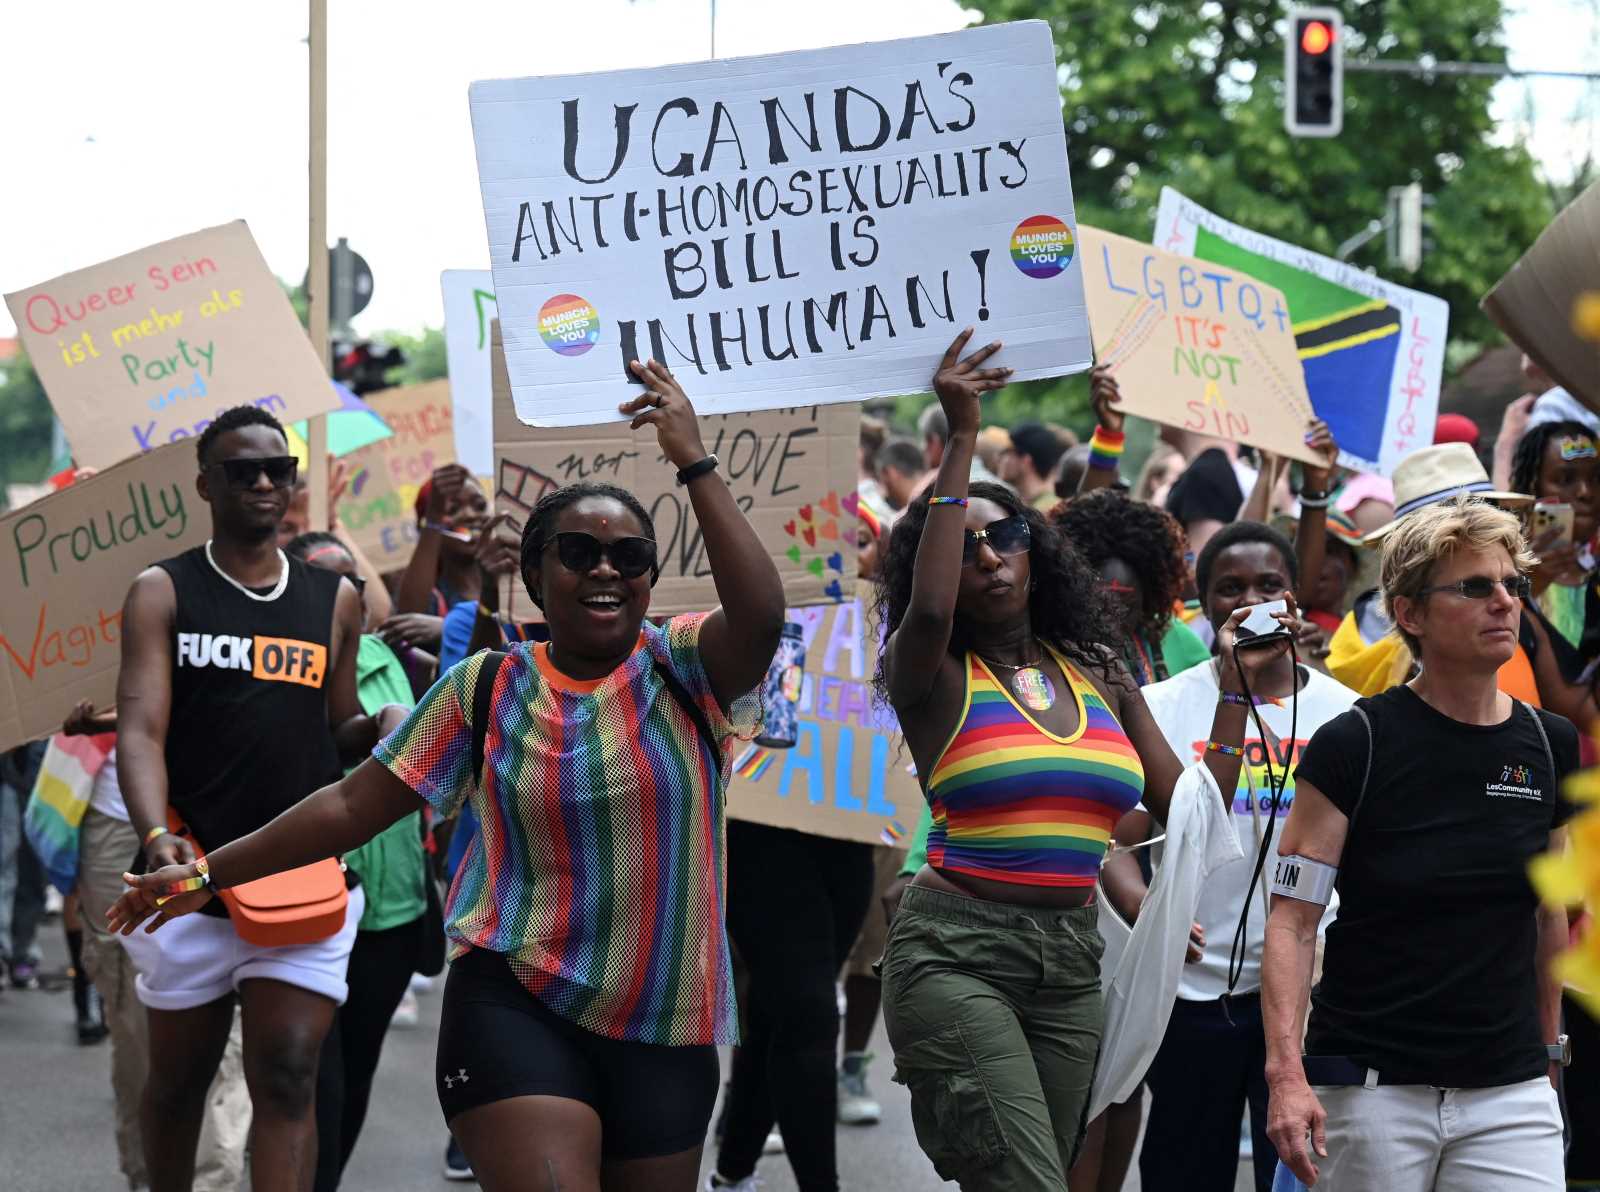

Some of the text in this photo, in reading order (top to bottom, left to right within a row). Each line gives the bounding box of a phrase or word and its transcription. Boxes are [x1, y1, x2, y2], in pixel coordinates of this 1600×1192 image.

[562, 62, 976, 184] UGANDA'S
[512, 138, 1028, 262] ANTI-HOMOSEXUALITY
[664, 215, 879, 299] BILL IS
[1016, 232, 1067, 244] MUNICH
[1021, 243, 1064, 255] LOVES
[1030, 253, 1057, 264] YOU
[25, 255, 218, 335] Queer Sein
[1103, 246, 1286, 333] LGBTQ+
[59, 331, 101, 367] ist
[111, 308, 183, 348] mehr
[543, 306, 590, 327] MUNICH
[550, 320, 590, 336] LOVES
[560, 329, 586, 343] YOU
[1174, 315, 1226, 349] IT'S
[121, 339, 215, 385] Party
[1173, 347, 1242, 385] NOT
[147, 372, 207, 411] und
[1185, 400, 1249, 439] SIN
[13, 482, 187, 587] Proudly
[0, 602, 122, 680] Vagit
[178, 632, 318, 681] FUCK OFF.
[777, 720, 896, 816] ALL
